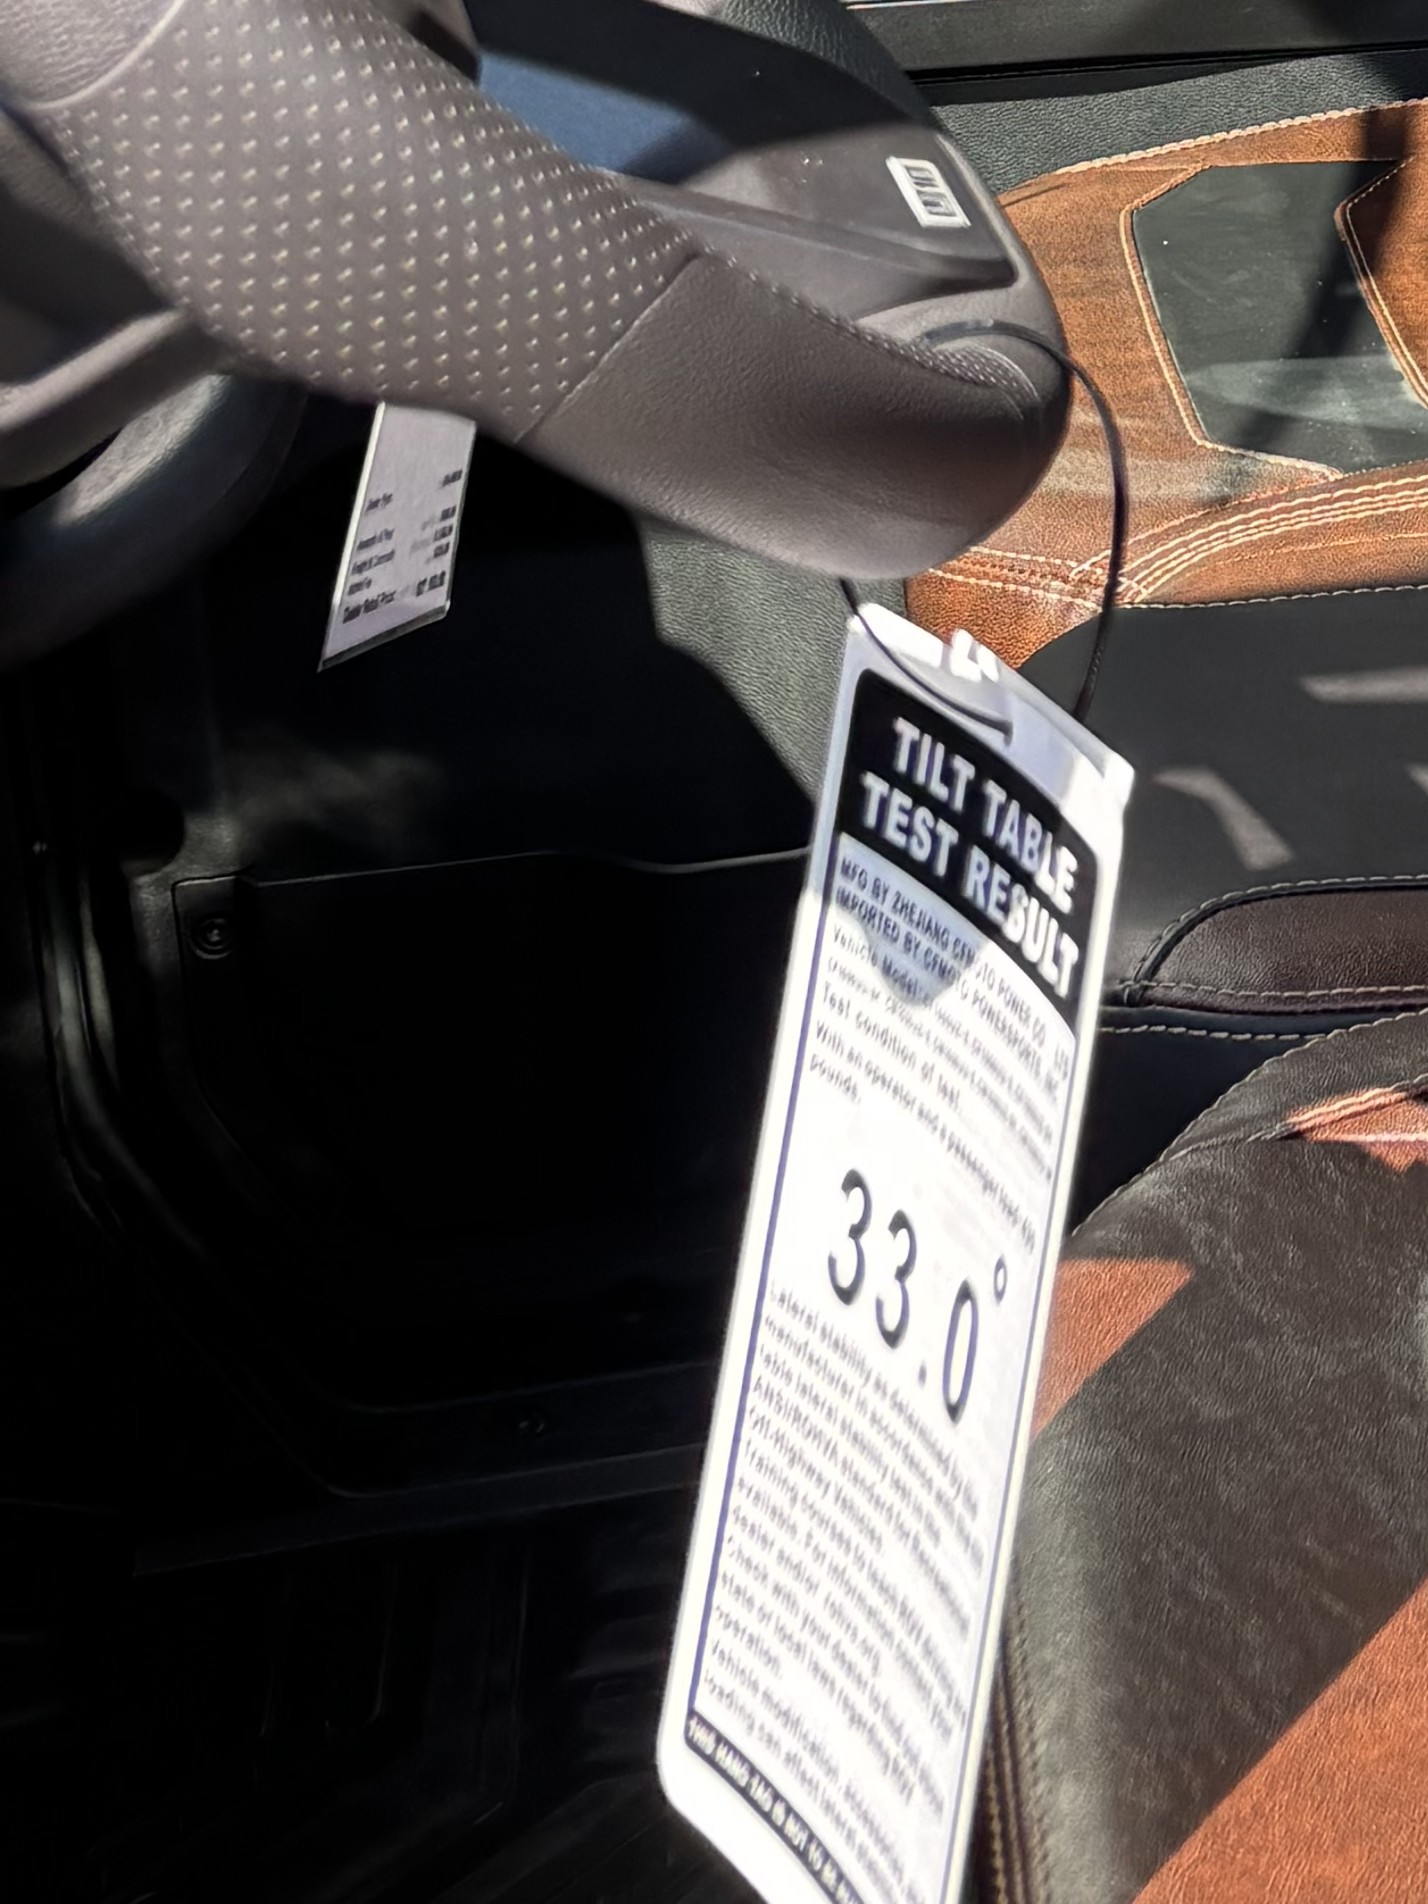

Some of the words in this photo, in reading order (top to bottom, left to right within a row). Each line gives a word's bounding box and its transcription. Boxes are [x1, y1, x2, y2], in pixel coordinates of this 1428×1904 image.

[893, 716, 976, 812] TILT
[982, 775, 1079, 914] TABLE
[860, 770, 959, 877] TEST
[963, 843, 1080, 999] RESULT
[870, 877, 890, 905] BY
[902, 930, 921, 959] BY
